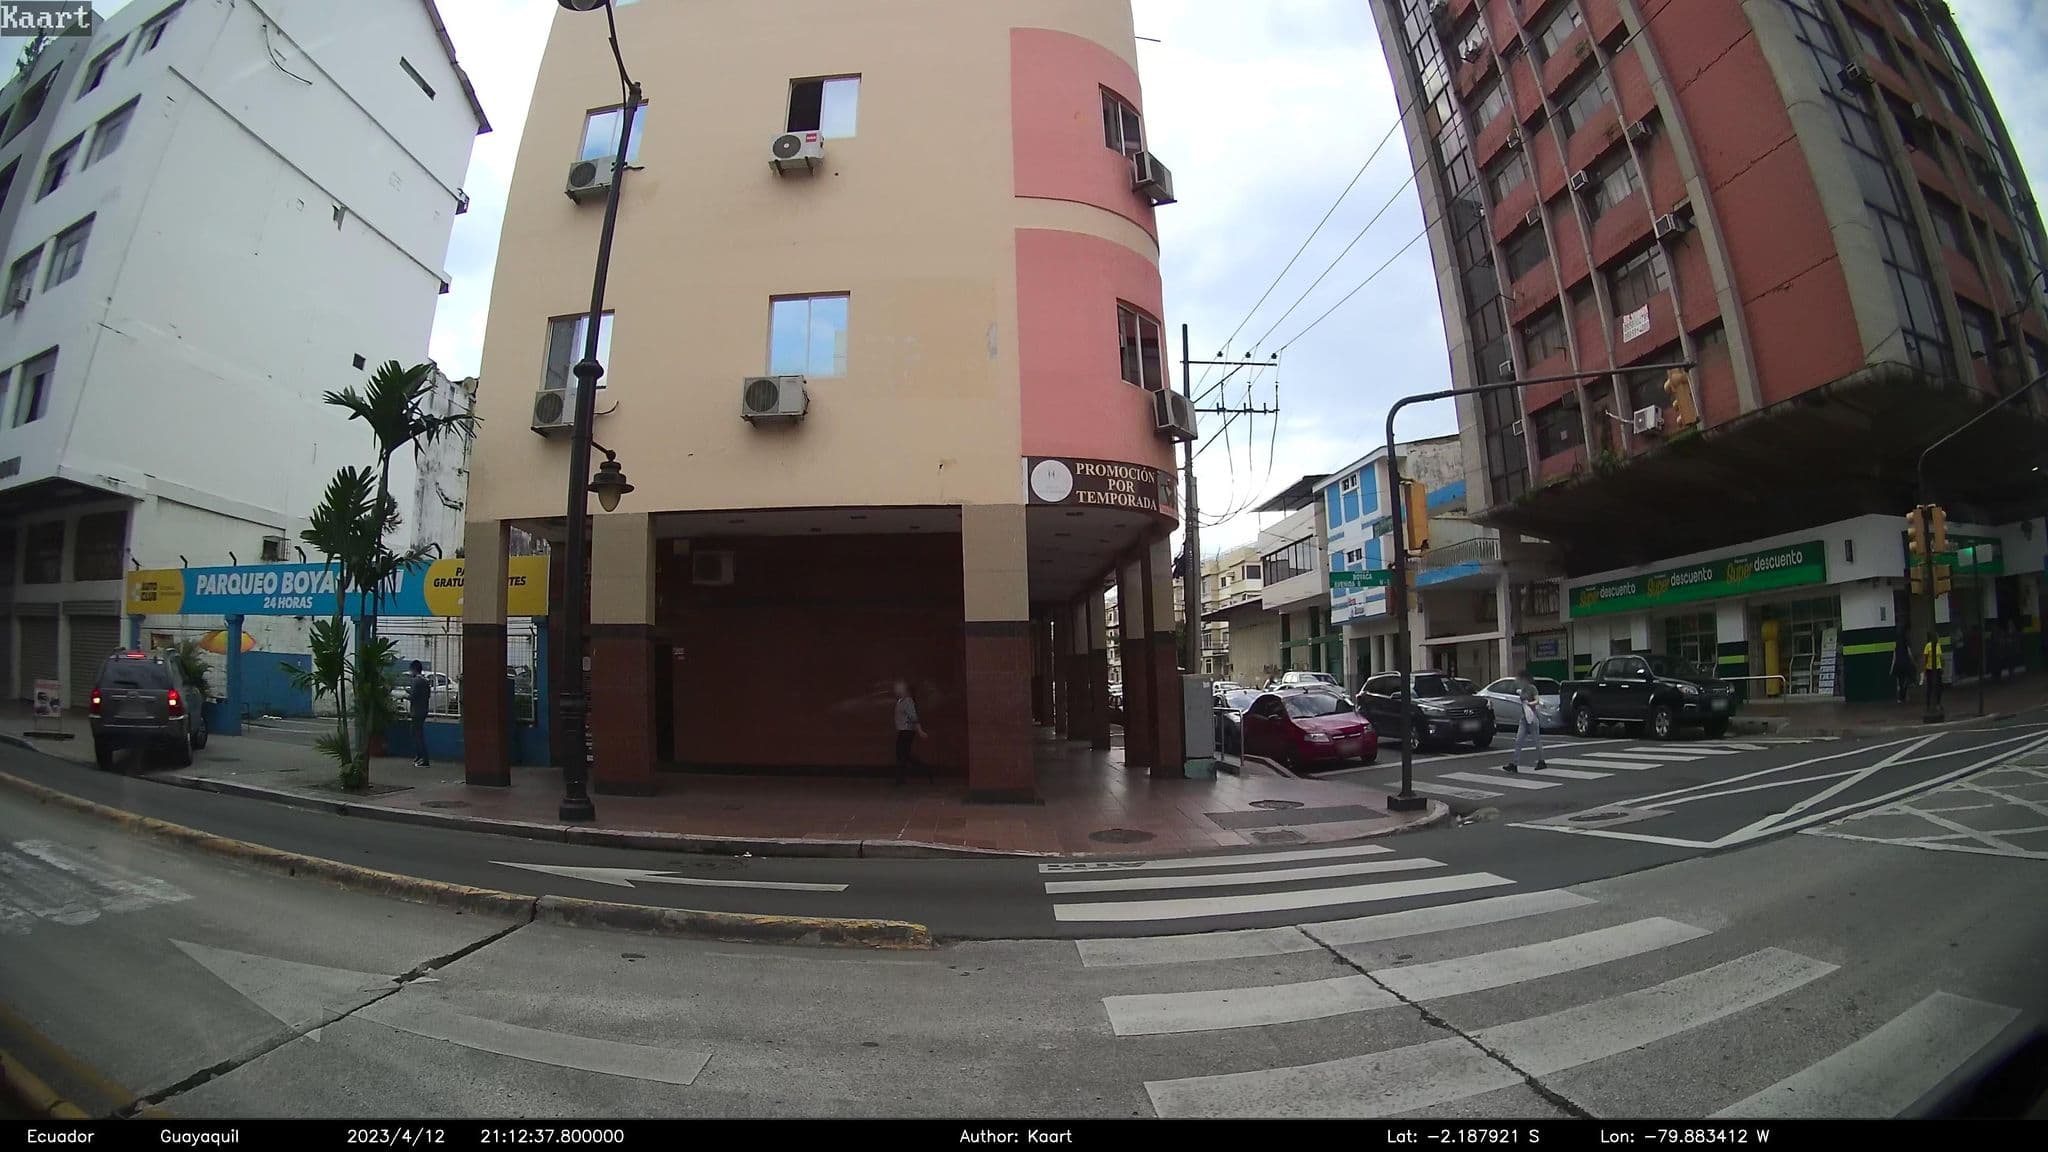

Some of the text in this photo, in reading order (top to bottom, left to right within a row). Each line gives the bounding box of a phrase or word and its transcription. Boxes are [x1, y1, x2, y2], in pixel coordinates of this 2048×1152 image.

[1076, 462, 1155, 484] PROMOCIÓN
[1108, 478, 1136, 493] POR
[1076, 490, 1157, 511] TEMPORADA
[1753, 549, 1803, 572] descuento
[196, 571, 277, 595] PARQUEO
[1670, 567, 1713, 587] descuento
[1600, 582, 1636, 598] descuento
[263, 597, 313, 609] 24 HORAS
